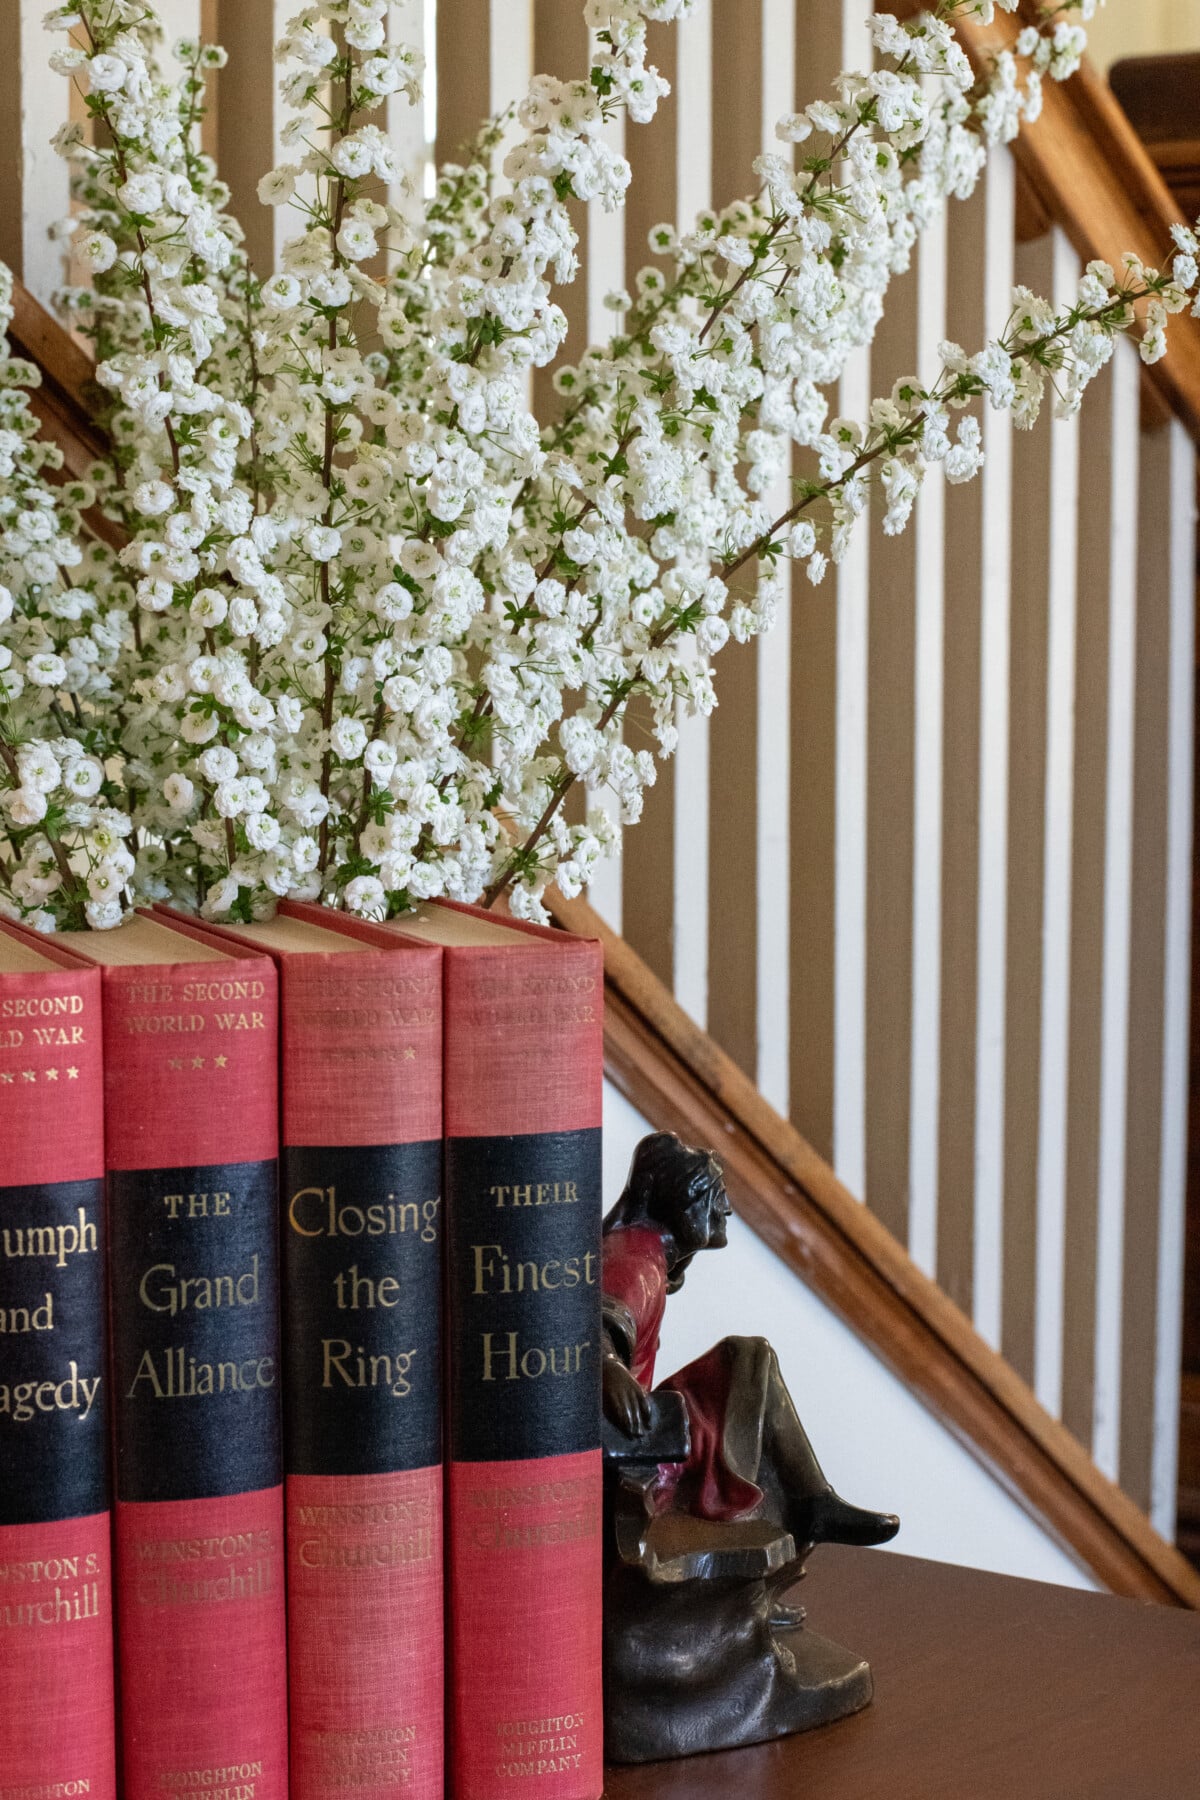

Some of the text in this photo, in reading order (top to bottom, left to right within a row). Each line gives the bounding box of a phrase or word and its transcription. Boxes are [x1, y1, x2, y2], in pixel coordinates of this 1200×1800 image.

[1, 994, 84, 1018] SECOND
[126, 981, 266, 1004] THE SECOND
[32, 1025, 86, 1046] WAR
[127, 1011, 266, 1035] WORLD WAR
[163, 1191, 232, 1220] THE
[490, 1180, 579, 1207] THEIR
[289, 1186, 441, 1243] Closing
[3, 1206, 98, 1268] umph
[470, 1244, 597, 1295] Finest
[139, 1253, 260, 1318] Grand
[333, 1265, 400, 1310] the
[321, 1338, 417, 1397] Ring
[481, 1331, 591, 1381] Hour
[125, 1347, 276, 1399] Alliance
[137, 1533, 254, 1563] WINSTON
[85, 1552, 100, 1575] S.
[501, 1734, 578, 1757] MIFFLIN
[494, 1753, 583, 1778] COMPANY
